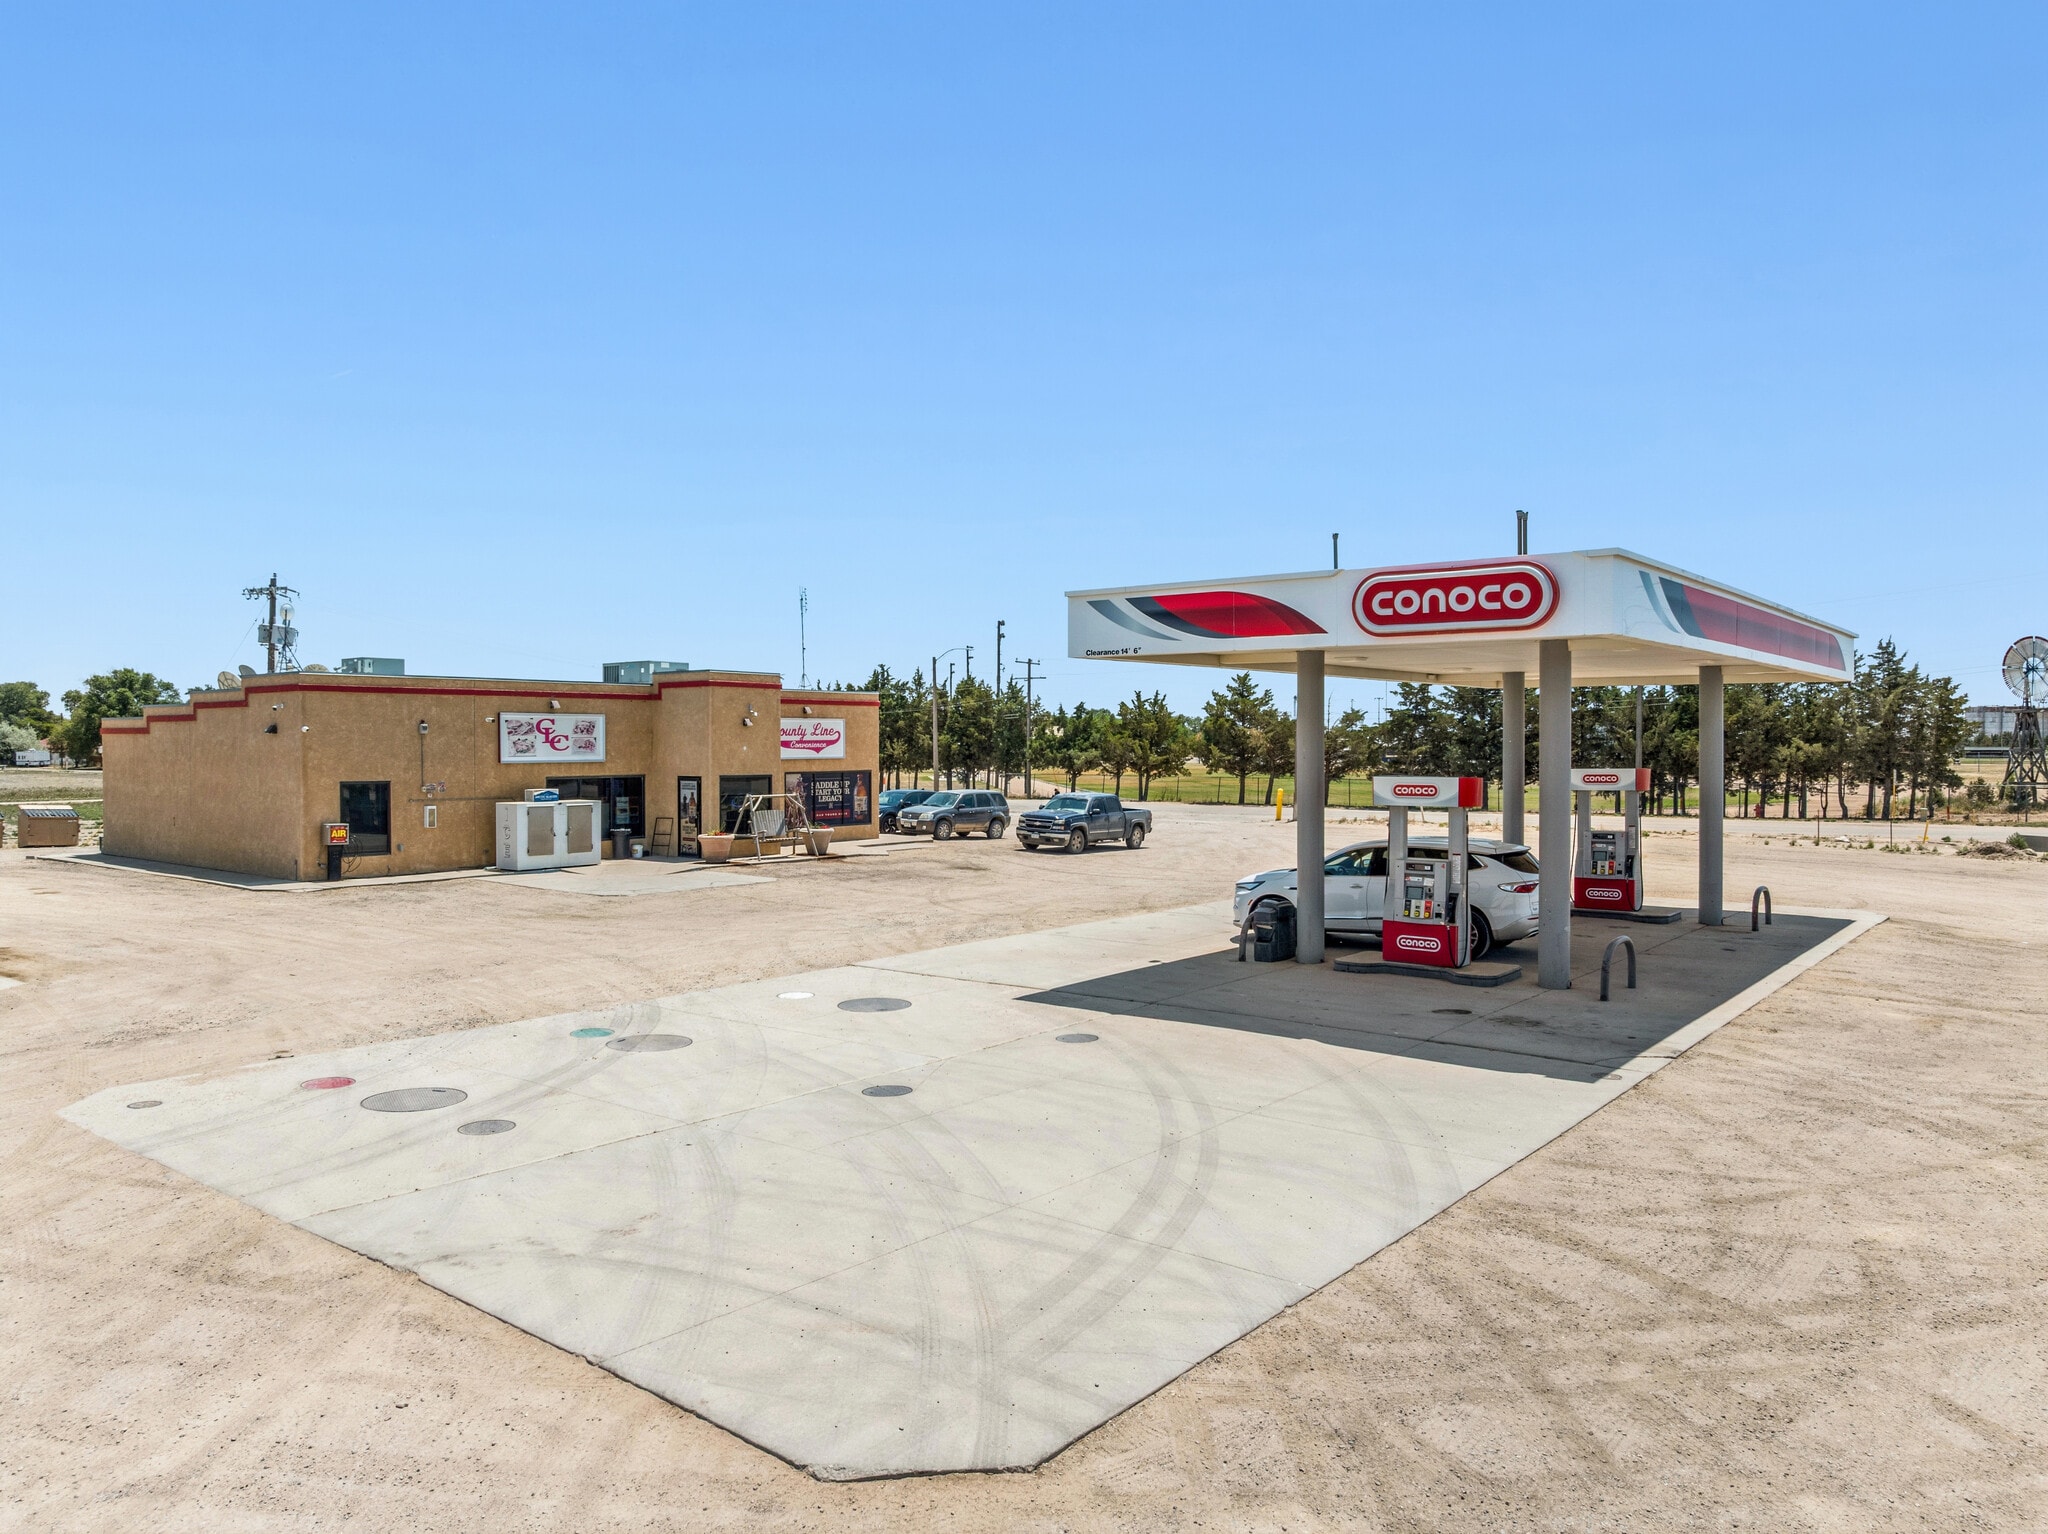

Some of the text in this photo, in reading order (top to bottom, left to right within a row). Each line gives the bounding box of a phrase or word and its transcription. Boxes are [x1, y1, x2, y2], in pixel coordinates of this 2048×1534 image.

[780, 722, 835, 740] ounty Line
[790, 740, 827, 749] Convenience
[331, 829, 347, 838] AIR
